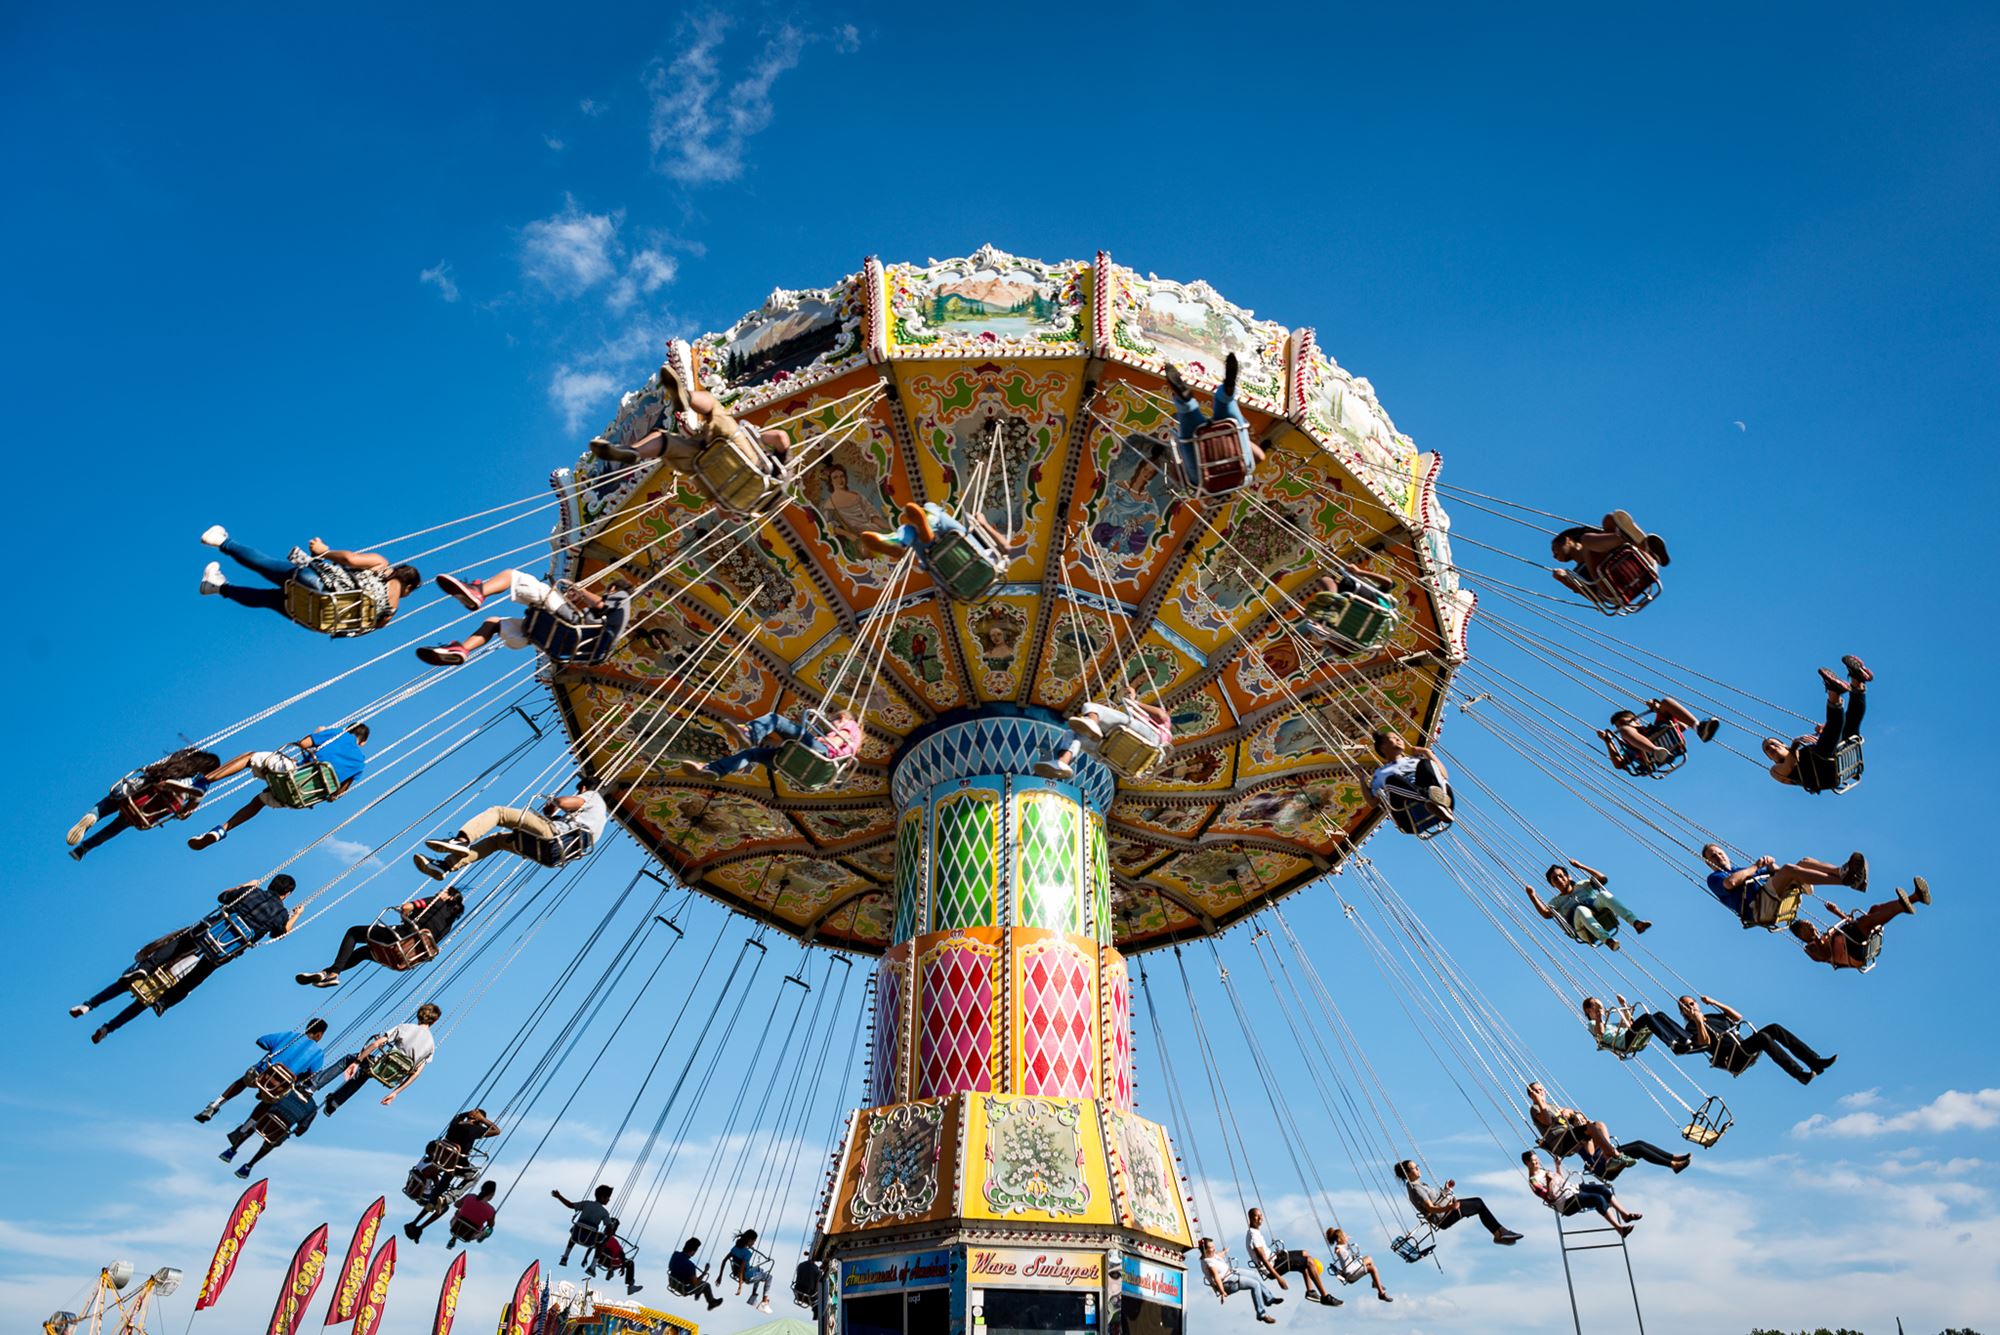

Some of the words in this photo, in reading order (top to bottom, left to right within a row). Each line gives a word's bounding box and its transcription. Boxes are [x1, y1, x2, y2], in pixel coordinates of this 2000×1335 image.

[234, 1199, 261, 1240] CORN
[292, 1249, 326, 1296] CORN
[337, 1256, 366, 1318] ROASTED
[360, 1216, 379, 1256] CORN
[369, 1259, 392, 1304] CORN
[845, 1263, 898, 1288] Amusements
[899, 1261, 910, 1287] of
[909, 1256, 947, 1281] America
[972, 1252, 1017, 1276] Wave
[1022, 1255, 1100, 1286] Swinger
[1151, 1273, 1159, 1296] of
[1157, 1272, 1179, 1297] America
